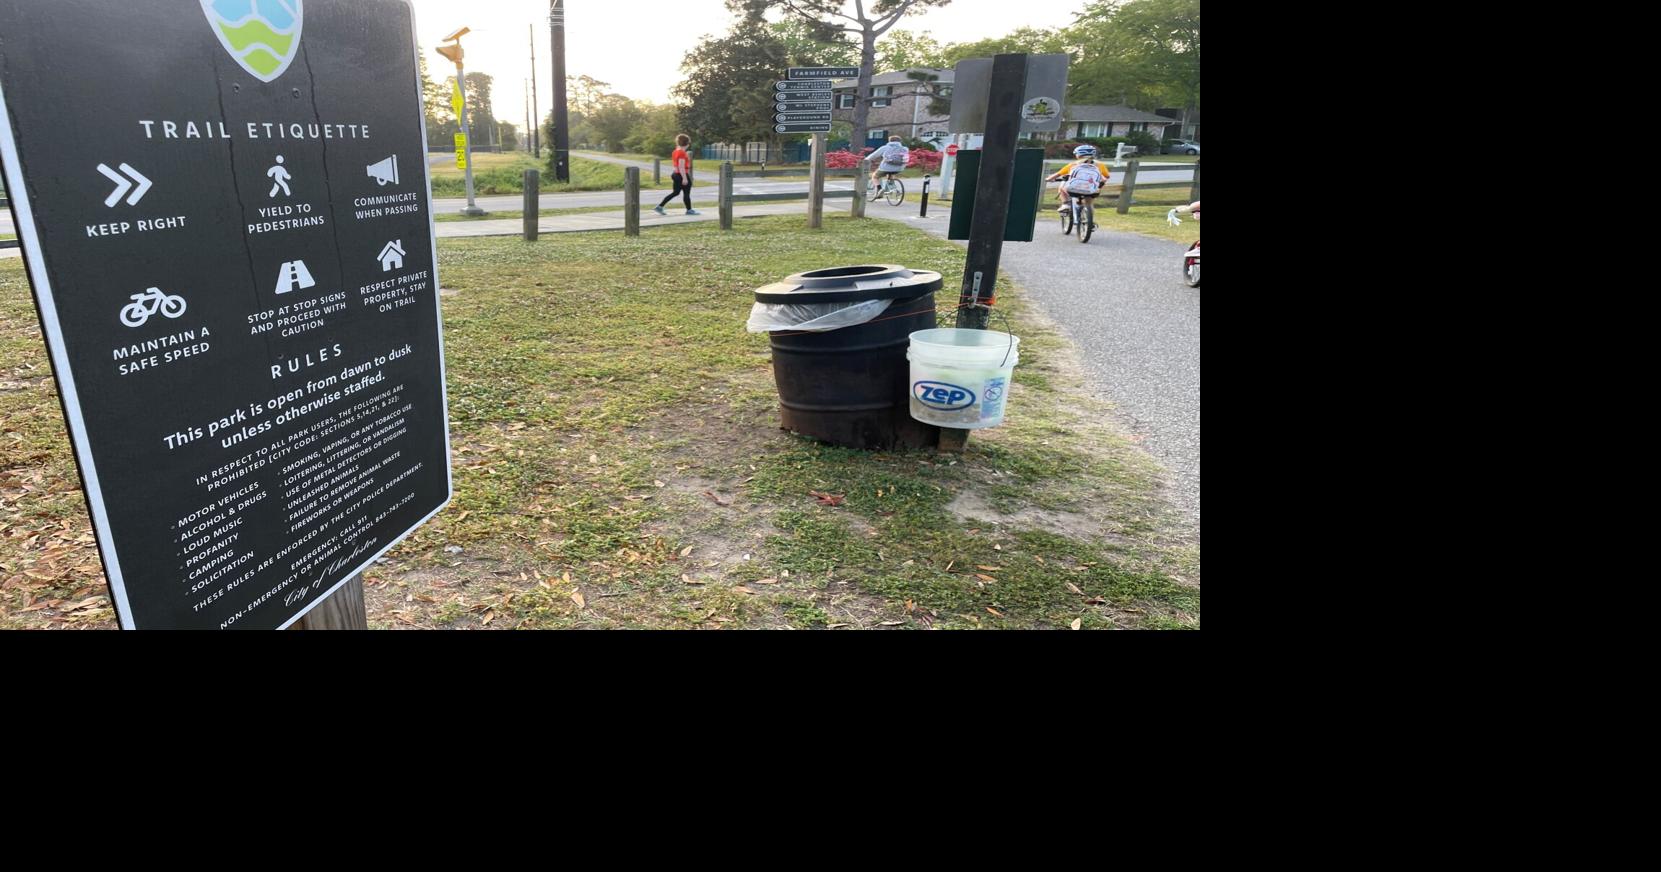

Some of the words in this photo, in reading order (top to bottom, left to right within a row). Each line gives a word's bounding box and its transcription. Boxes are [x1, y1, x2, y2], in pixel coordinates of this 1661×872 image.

[139, 120, 232, 140] TRAIL
[248, 121, 370, 140] ETIQUETTE
[258, 204, 292, 218] YIELD
[296, 203, 311, 213] TO
[354, 193, 417, 207] COMMUNICATE
[355, 209, 382, 220] WHEN
[384, 203, 418, 216] PASSING
[86, 222, 130, 237] KEEP
[137, 216, 186, 231] RIGHT
[248, 215, 325, 234] PEDESTRIANS
[360, 279, 395, 295] RESPECT
[397, 270, 427, 285] PRIVATE
[363, 289, 407, 306] PROPERTY,
[410, 281, 427, 293] STAY
[247, 310, 274, 324] STOP
[278, 305, 291, 316] AT
[293, 299, 317, 311] STOP
[320, 291, 346, 305] SIGNS
[250, 322, 274, 335] AND
[277, 309, 321, 327] PROCEED
[323, 302, 346, 315] WITH
[379, 304, 392, 313] ON
[394, 295, 416, 308] TRAIL
[113, 330, 194, 360] MAINTAIN
[201, 327, 210, 337] A
[281, 318, 324, 337] CAUTION
[119, 356, 159, 375] SAFE
[164, 342, 210, 363] SPEED
[271, 344, 342, 379] RULES
[163, 427, 203, 449] This
[208, 409, 247, 437] park
[250, 403, 263, 416] is
[267, 388, 303, 409] open
[306, 375, 337, 394] from
[340, 361, 372, 380] dawn
[374, 355, 386, 367] to
[389, 344, 412, 361] dusk
[221, 420, 272, 448] unless
[276, 391, 341, 425] otherwise
[344, 370, 385, 396] staffed.
[196, 474, 208, 485] IN
[211, 454, 252, 478] RESPECT
[255, 447, 268, 457] TO
[271, 440, 286, 450] ALL
[288, 427, 309, 442] PARK
[311, 416, 336, 431] USERS,
[338, 408, 351, 419] THE
[353, 390, 391, 412] FOLLOWING
[392, 384, 404, 394] ARE
[282, 450, 321, 474] SMOKING,
[322, 436, 350, 454] VAPING,
[350, 430, 360, 439] OR
[361, 423, 374, 434] ANY
[375, 409, 401, 427] TOBACCO
[401, 402, 413, 413] USE
[284, 462, 325, 487] LOITERING,
[326, 441, 361, 463] LITTERING,
[362, 436, 372, 444] OR
[372, 417, 405, 439] VANDALISM
[207, 459, 265, 492] PROHIBITED
[294, 434, 318, 450] CODE:
[320, 416, 355, 437] SECTIONS
[285, 485, 300, 498] USE
[301, 478, 312, 488] OF
[313, 467, 336, 483] METAL
[337, 446, 373, 470] DETECTORS
[373, 440, 382, 449] OR
[383, 427, 407, 445] DIGGING
[287, 481, 329, 510] UNLEASHED
[330, 464, 360, 486] ANIMALS
[289, 501, 318, 521] FAILURE
[319, 493, 329, 503] TO
[330, 477, 357, 497] REMOVE
[358, 463, 382, 481] ANIMAL
[382, 450, 401, 466] WASTE
[178, 503, 215, 528] MOTOR
[218, 481, 259, 507] VEHICLES
[181, 513, 226, 541] ALCOHOL
[229, 508, 235, 516] &
[237, 491, 267, 511] DRUGS
[290, 504, 331, 533] FIREWORKS
[332, 499, 342, 507] OR
[343, 477, 374, 500] WEAPONS
[184, 535, 210, 554] LOUD
[213, 517, 243, 538] MUSIC
[186, 532, 239, 567] PROFANITY
[193, 588, 224, 612] THESE
[227, 569, 255, 591] RULES
[257, 556, 274, 572] ARE
[276, 529, 318, 560] ENFORCED
[320, 521, 329, 532] BY
[331, 511, 345, 524] THE
[346, 501, 360, 515] CITY
[362, 486, 384, 504] POLICE
[291, 535, 338, 571] EMERGENCY:
[339, 524, 356, 538] CALL
[357, 515, 368, 526] 911
[189, 549, 234, 580] CAMPING
[191, 550, 254, 593] SOLICITATION
[220, 572, 298, 630] NON-EMERGENCY
[300, 564, 312, 575] OR
[314, 543, 343, 566] ANIMAL
[343, 521, 374, 545] CONTROL
[283, 585, 310, 607] City
[312, 565, 330, 589] of
